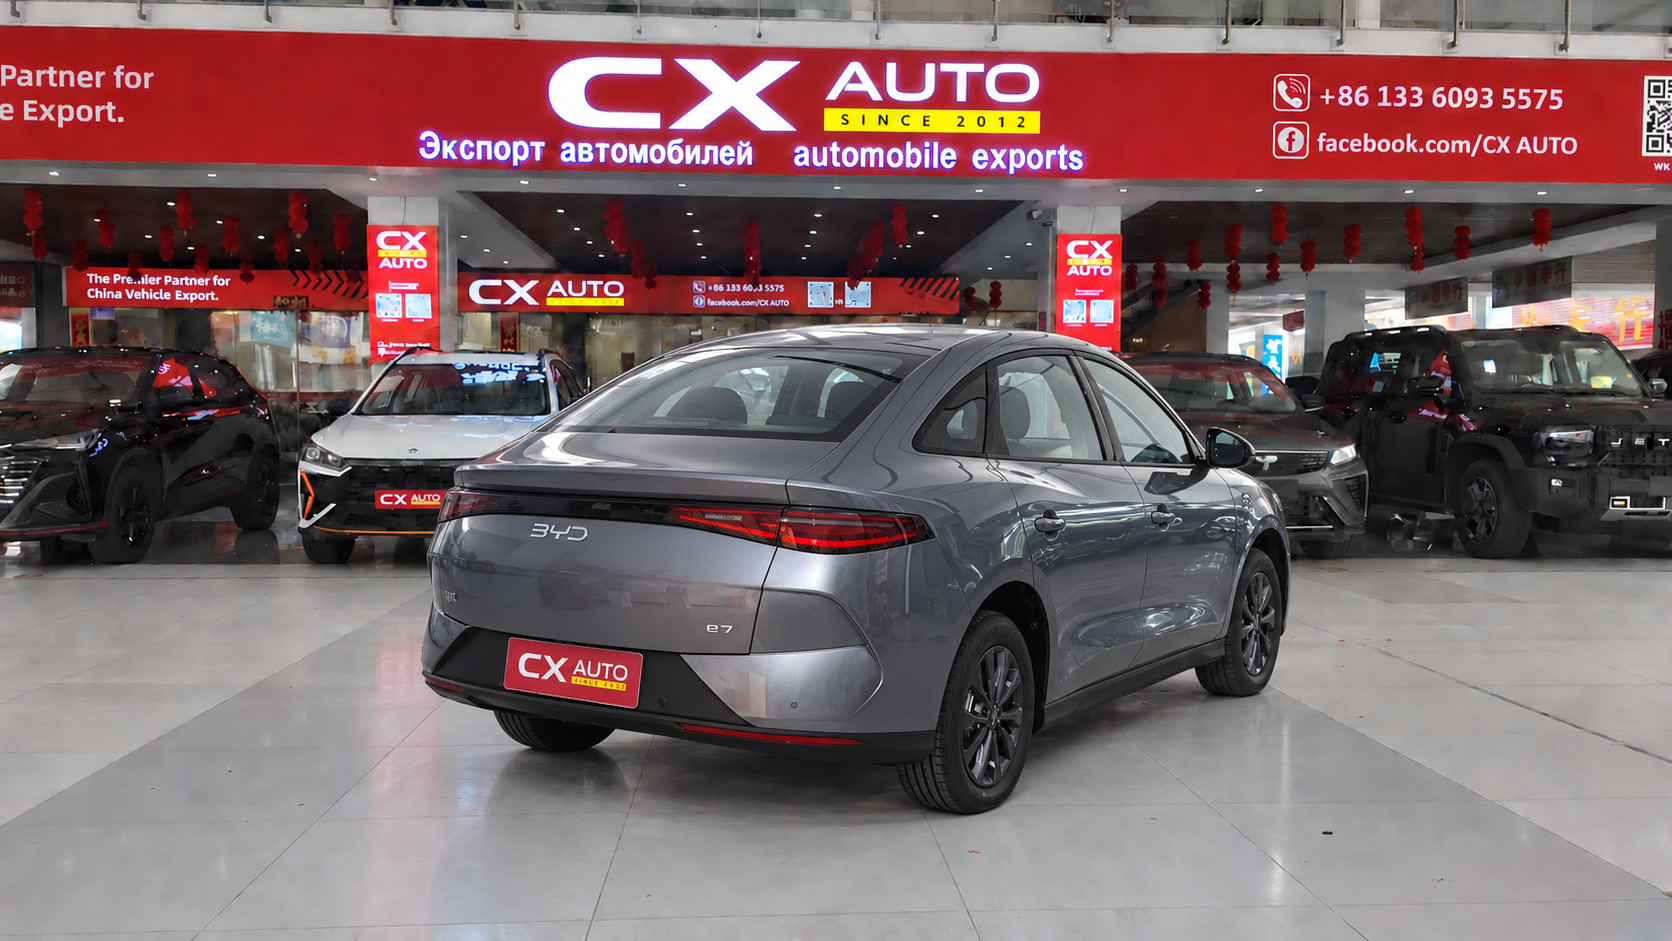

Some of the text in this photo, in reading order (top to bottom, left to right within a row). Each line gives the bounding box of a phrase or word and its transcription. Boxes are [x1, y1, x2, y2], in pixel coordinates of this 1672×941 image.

[0, 65, 154, 88] Partner for
[548, 56, 1040, 131] CX AUTO
[1320, 85, 1563, 110] +86 133 6093 5575
[24, 100, 124, 128] Export.
[841, 114, 1026, 128] SINCE 2012
[419, 131, 546, 167] Экспорт
[560, 138, 753, 166] автомобилей
[1317, 133, 1578, 157] facebook.com/CX AUTO
[793, 141, 1084, 174] automobile exports
[376, 231, 427, 250] CX
[1066, 240, 1114, 259] CX
[378, 257, 428, 269] AUTO
[1067, 265, 1113, 276] AUTO
[87, 273, 110, 284] The
[164, 275, 210, 286] Partner
[213, 275, 231, 286] for
[708, 284, 724, 292] +86
[726, 284, 741, 292] 133
[765, 284, 785, 292] 5575
[87, 288, 219, 303] China Vehicle Export.
[468, 279, 625, 305] CX AUTO
[770, 299, 790, 307] AUTO
[380, 493, 441, 505] CX AUTO
[530, 523, 589, 541] BYD
[706, 623, 734, 634] e7
[518, 652, 629, 683] CX AUTO
